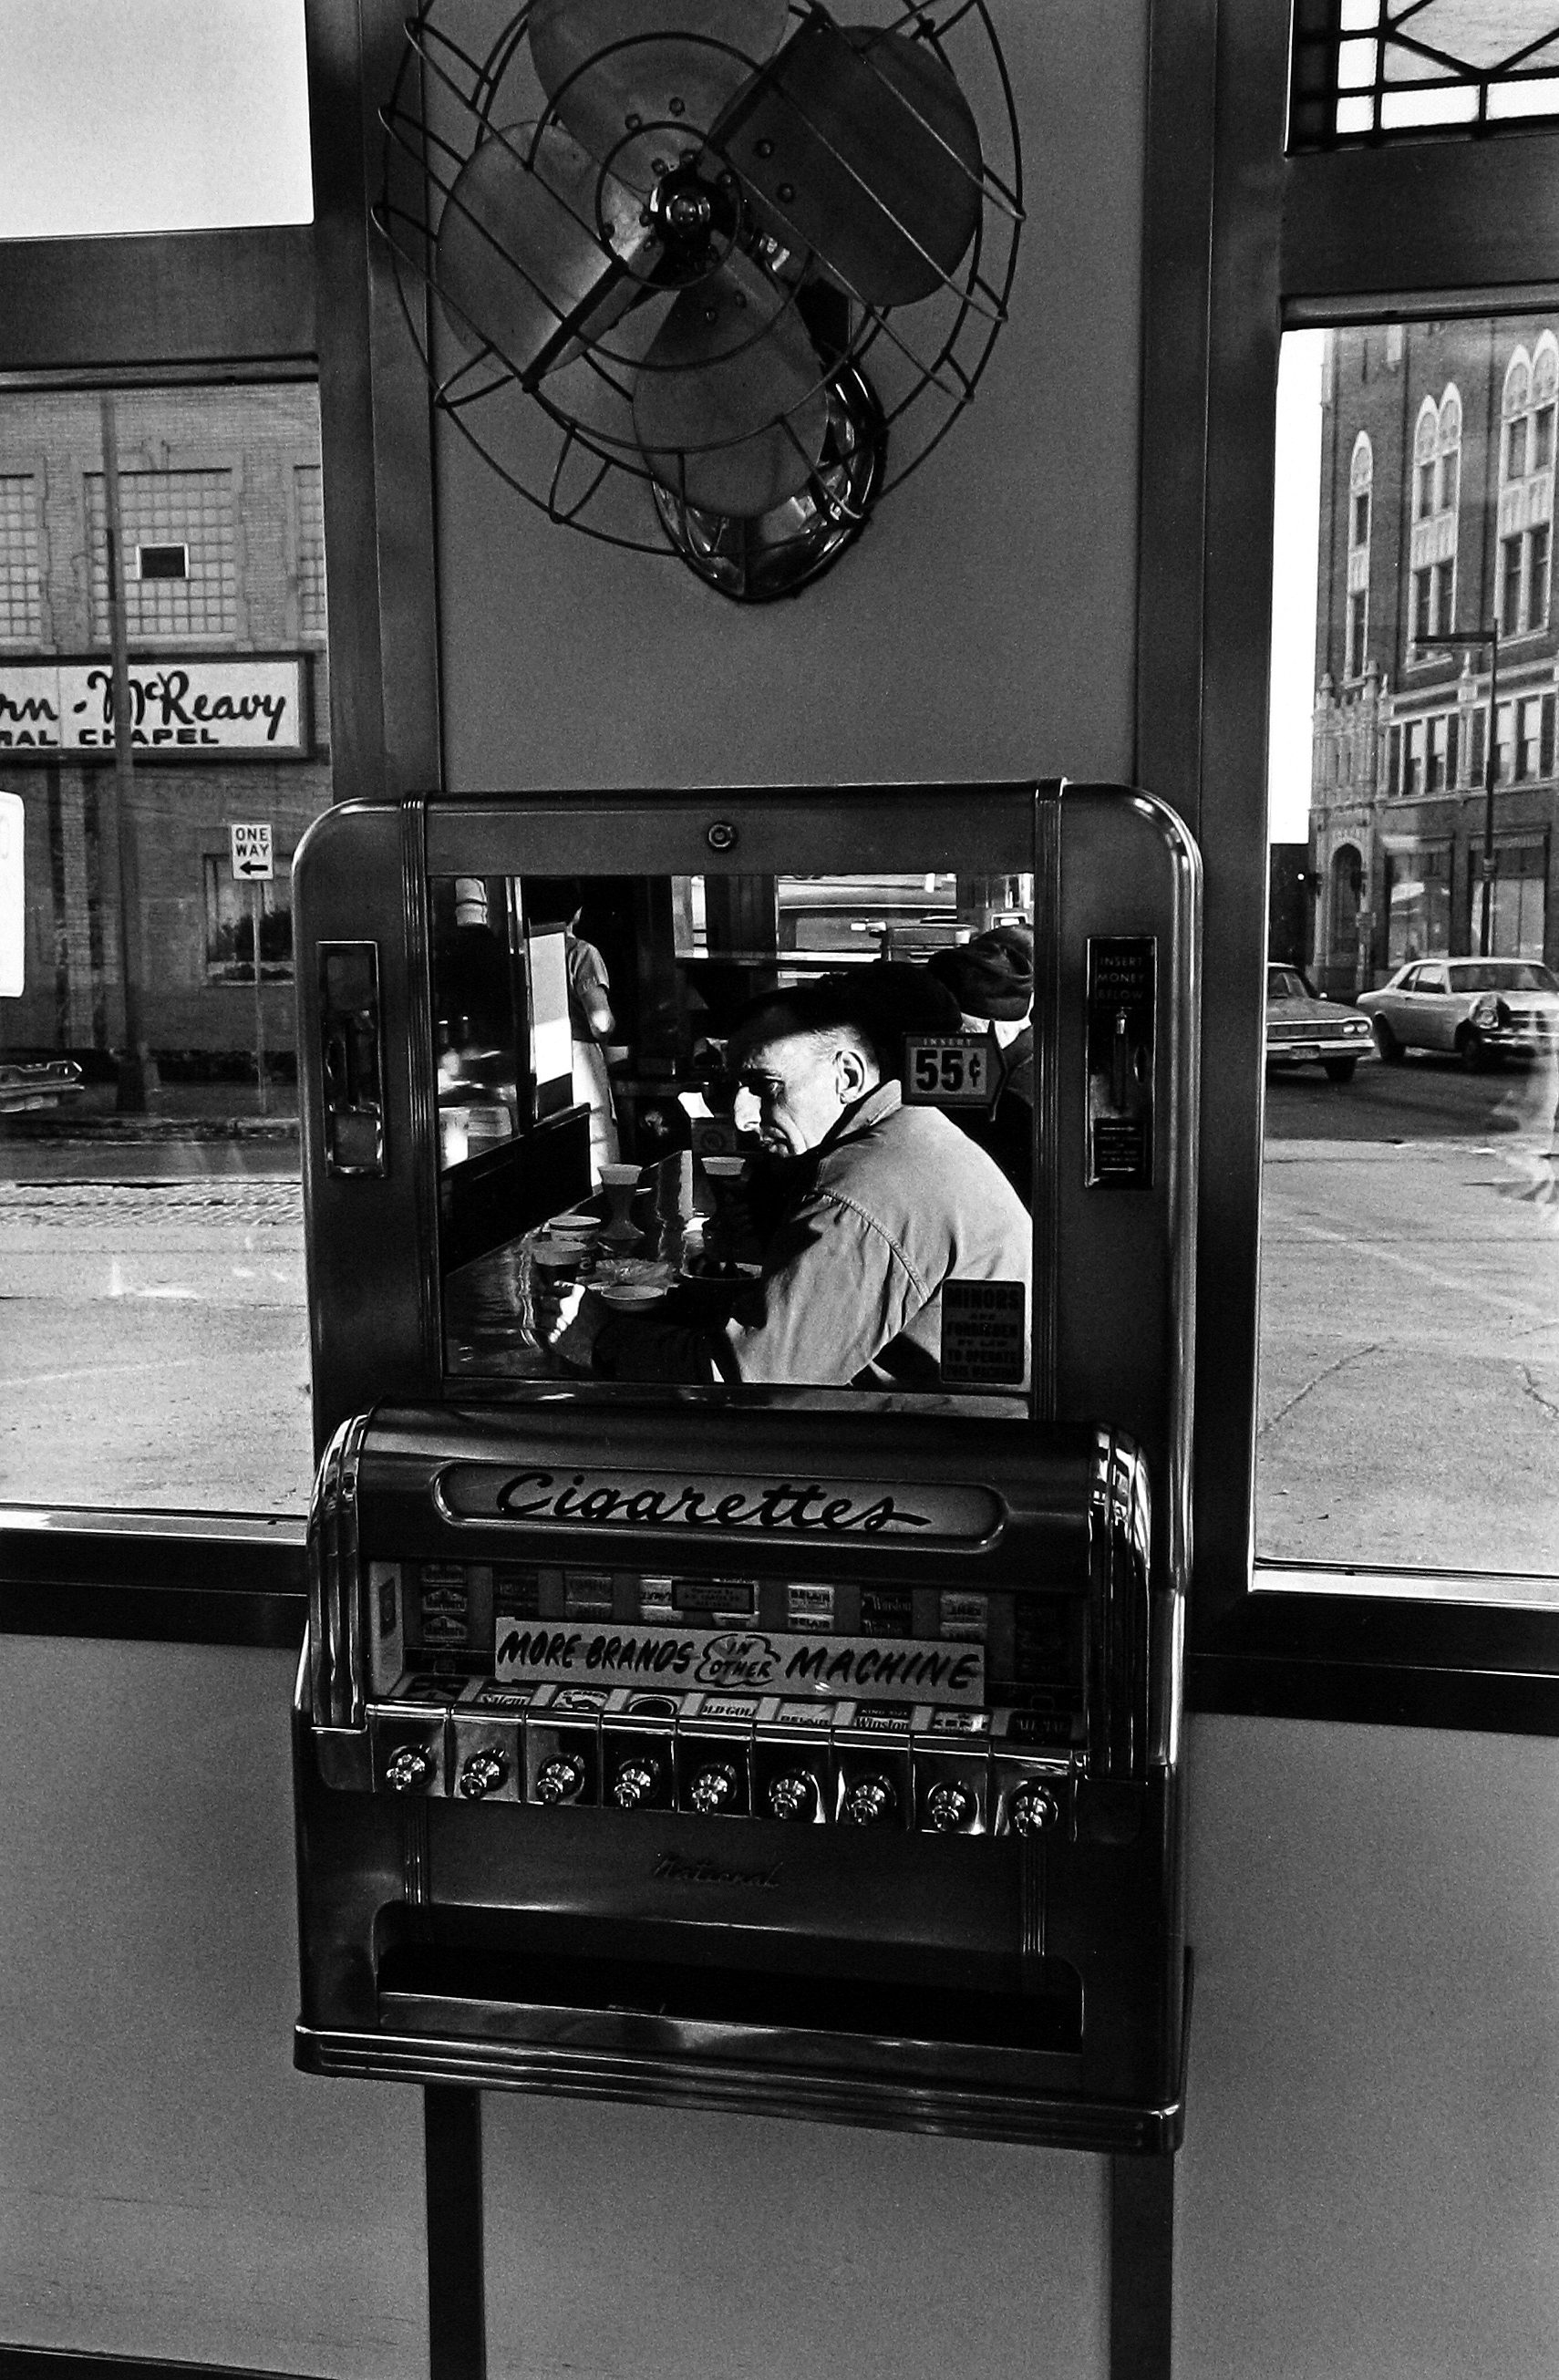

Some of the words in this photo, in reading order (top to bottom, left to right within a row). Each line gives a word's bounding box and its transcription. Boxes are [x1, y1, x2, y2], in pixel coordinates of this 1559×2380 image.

[88, 670, 285, 740] McReavy
[236, 828, 268, 841] ONE
[236, 844, 269, 857] WAY
[1100, 956, 1141, 967] INSERT
[1098, 972, 1144, 983] MONEY
[1099, 988, 1143, 1000] BELOW
[946, 1288, 1019, 1309] MINORS
[496, 1470, 932, 1531] Cigarettes
[498, 1630, 582, 1669] MORE
[586, 1635, 694, 1674] BRANDS
[728, 1641, 752, 1655] IN
[709, 1660, 773, 1678] OTHER
[785, 1646, 980, 1689] MACHINE
[853, 1716, 910, 1730] Winston
